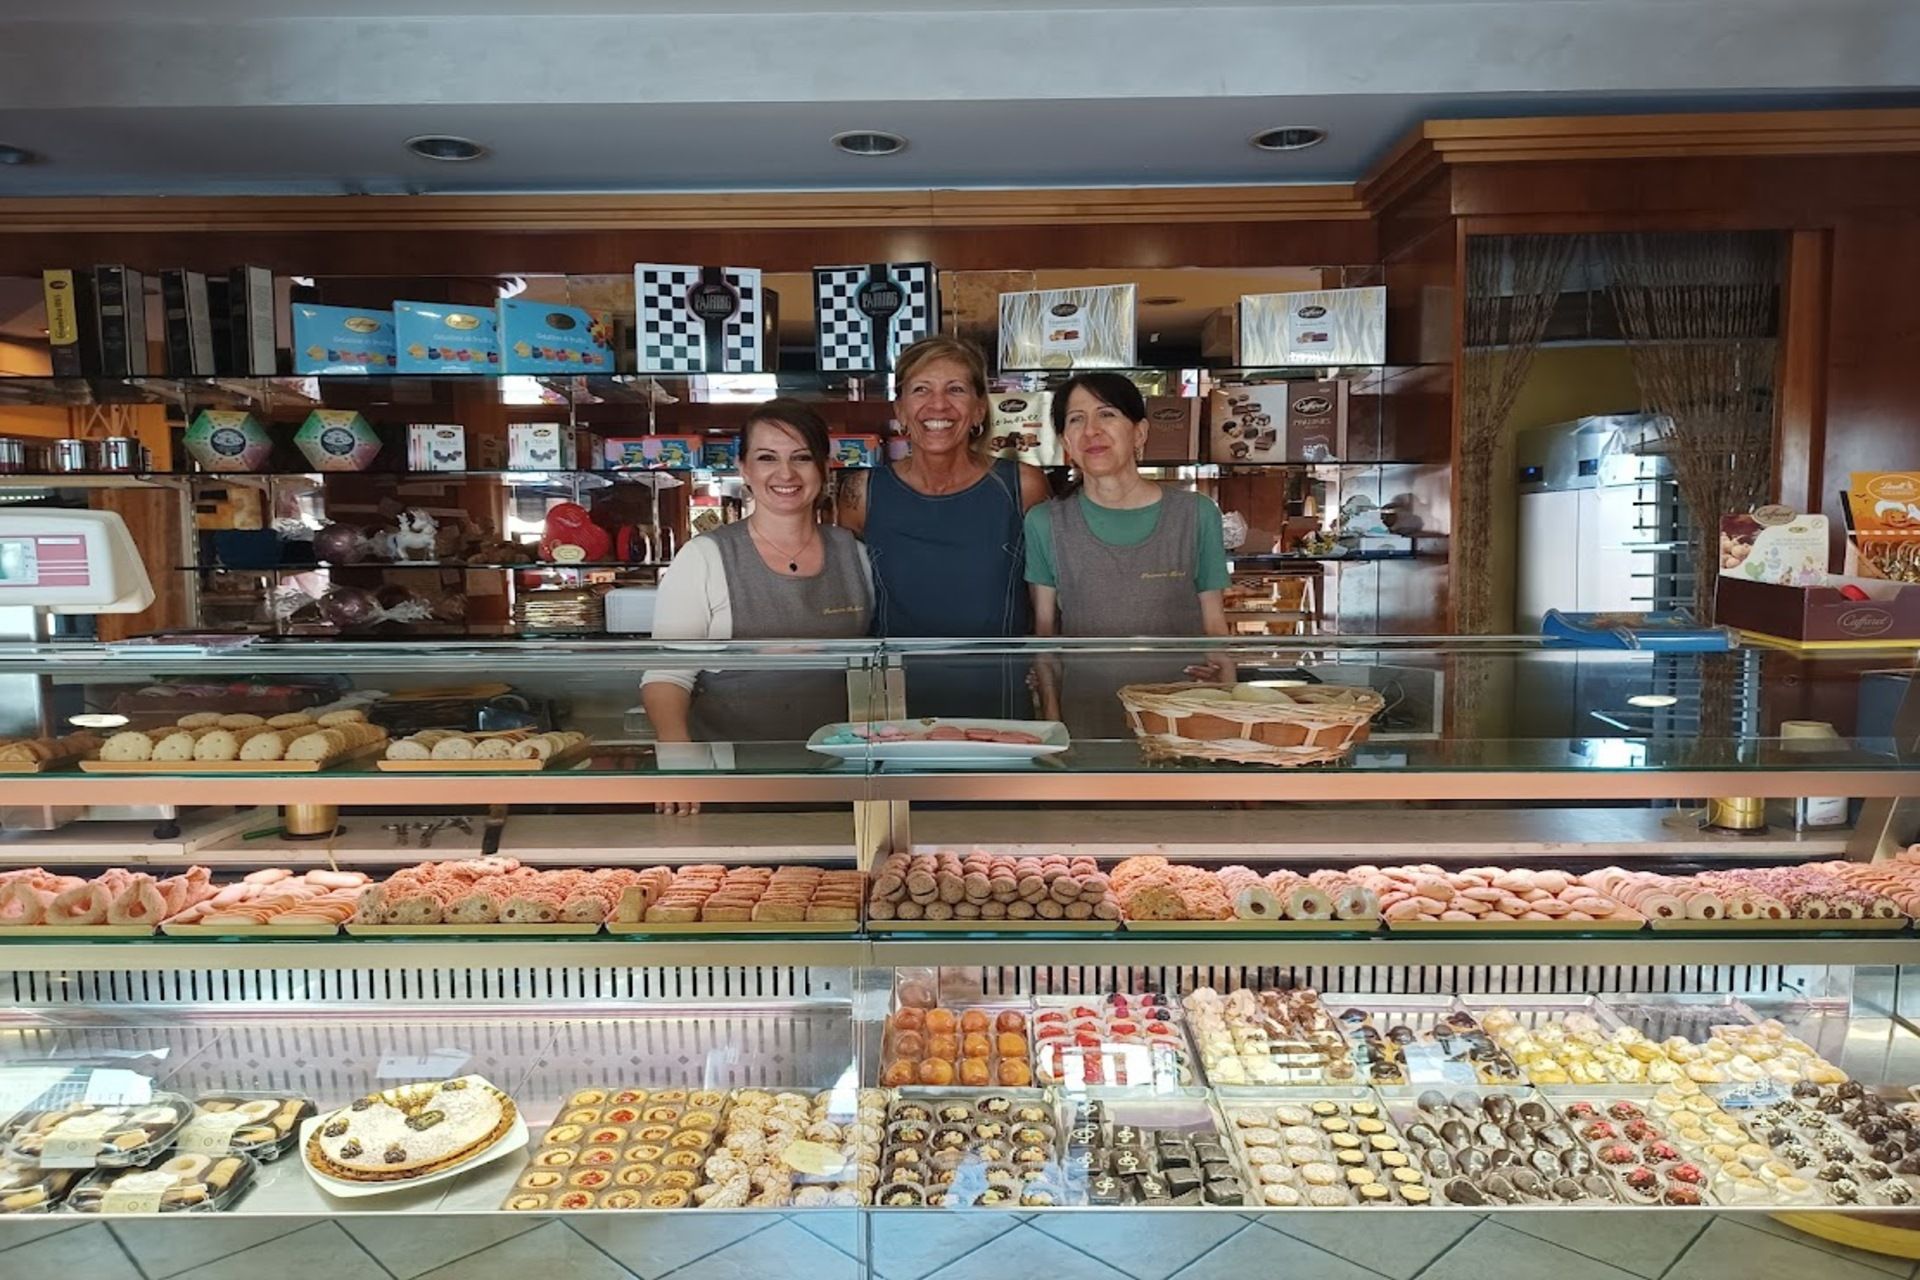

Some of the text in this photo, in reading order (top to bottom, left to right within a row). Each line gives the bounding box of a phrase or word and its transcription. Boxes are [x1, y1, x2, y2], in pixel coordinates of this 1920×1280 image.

[694, 294, 731, 310] PAIRING
[862, 291, 898, 308] PAIRING
[1843, 613, 1890, 631] Caffarel
